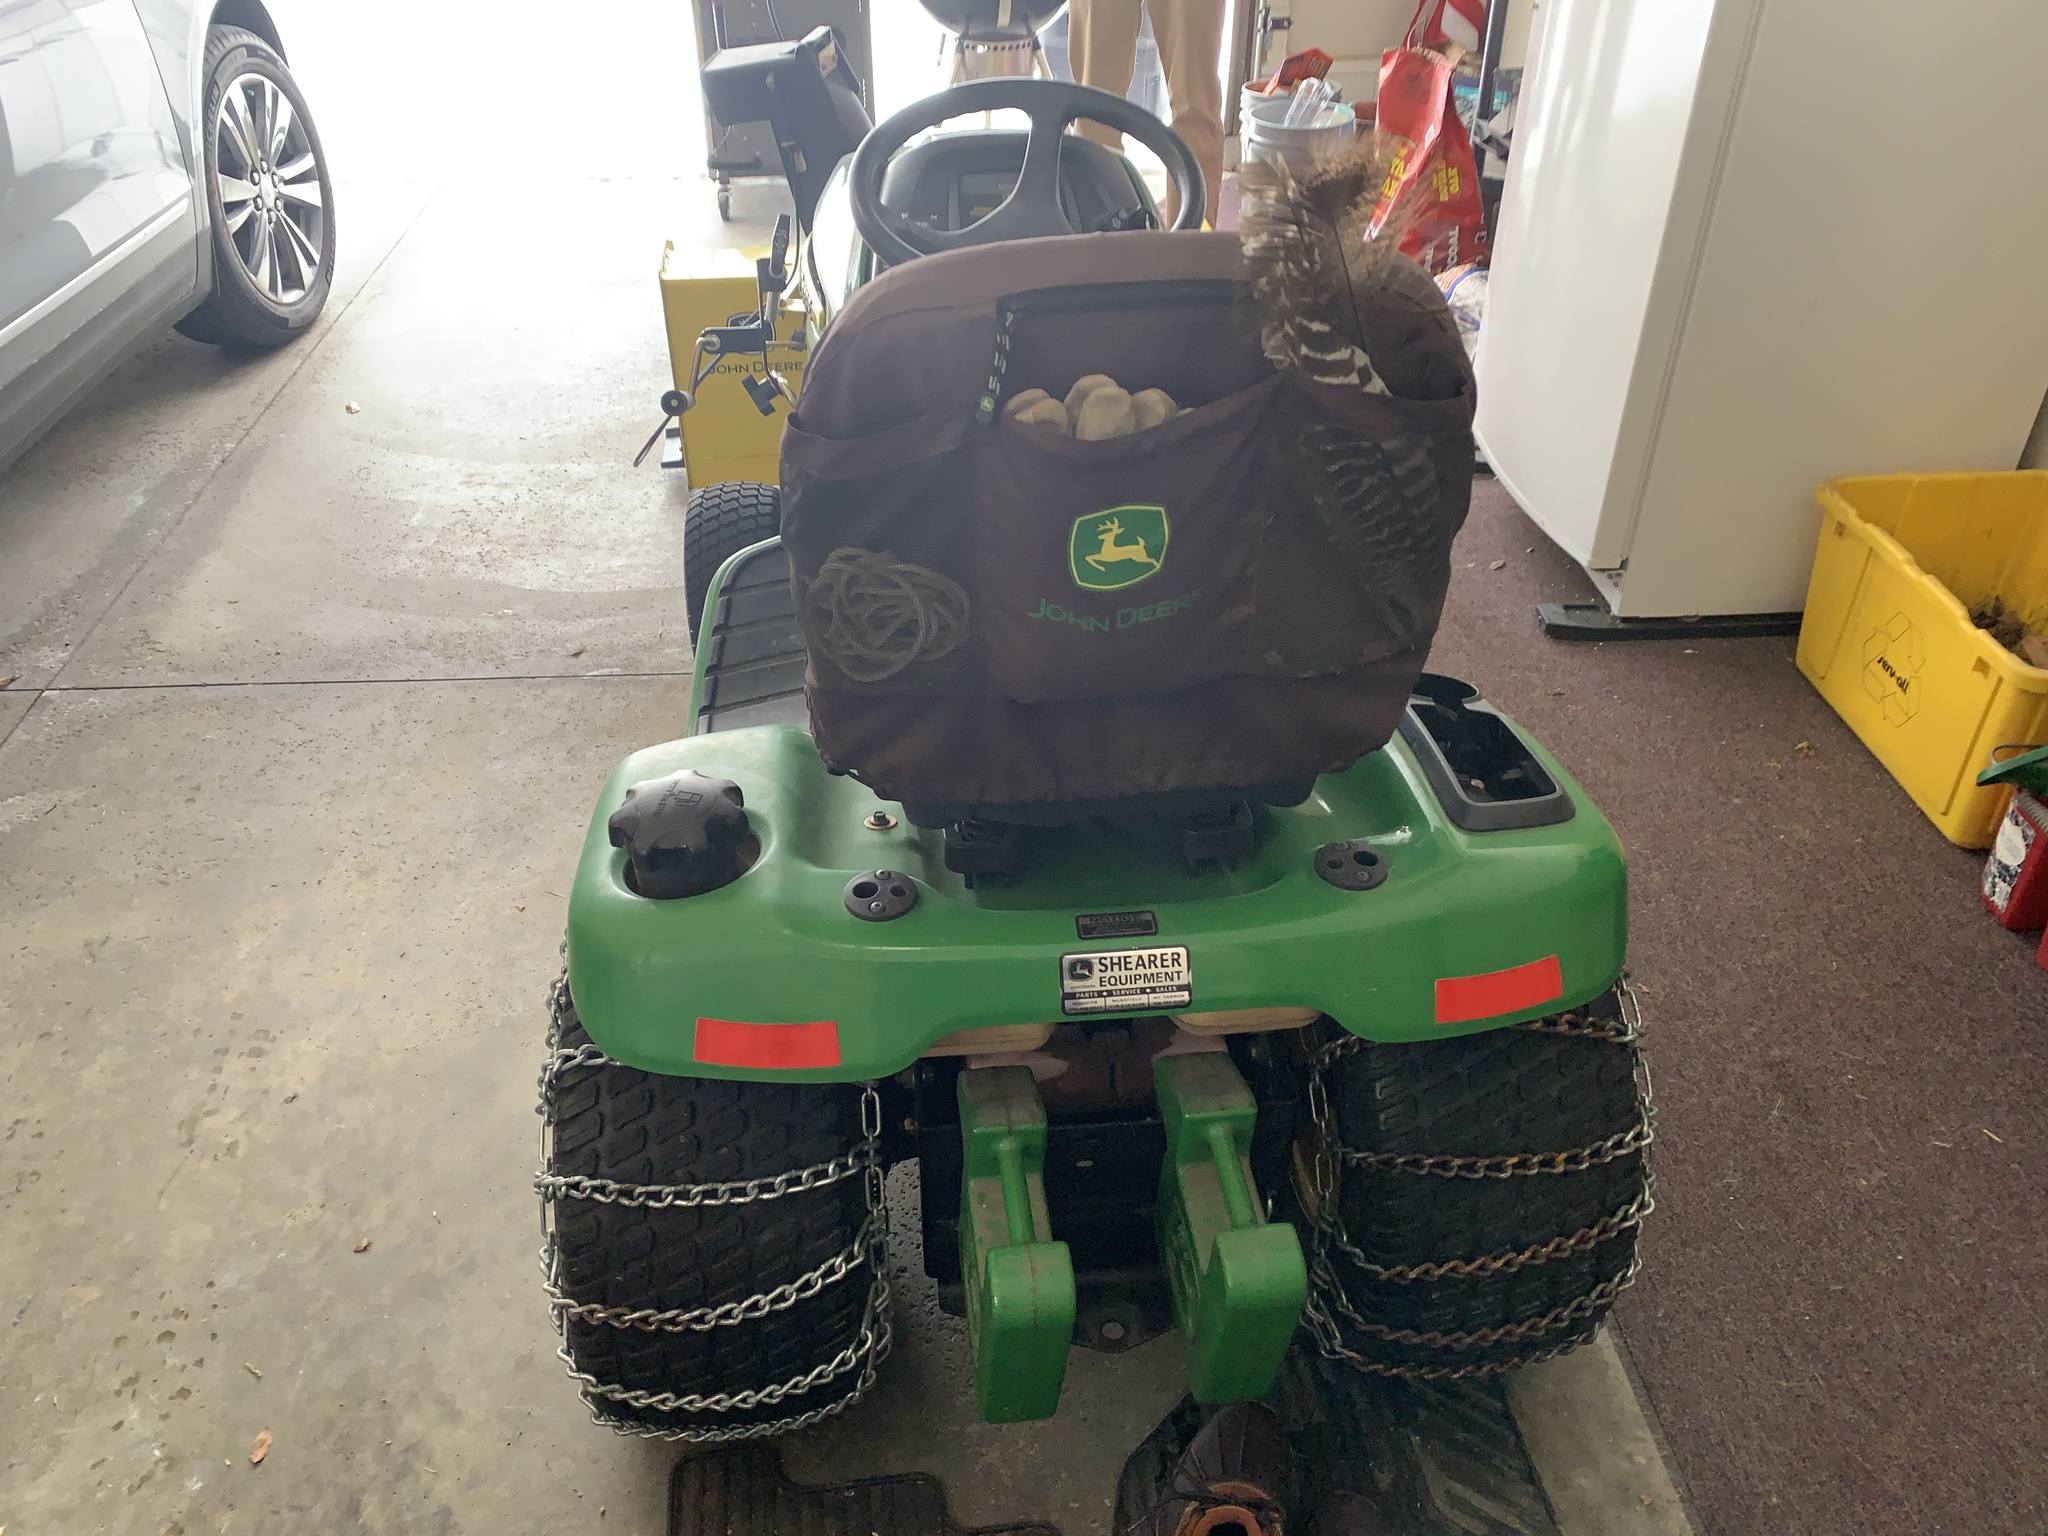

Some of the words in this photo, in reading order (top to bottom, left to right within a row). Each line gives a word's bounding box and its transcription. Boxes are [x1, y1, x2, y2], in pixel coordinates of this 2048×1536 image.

[1028, 597, 1110, 632] JOHN
[1098, 952, 1182, 973] SHEARER
[1099, 970, 1183, 988] EQUIPMENT
[1075, 991, 1098, 999] PARTS
[1112, 988, 1141, 996] SERVICE
[1155, 985, 1177, 993] SALES
